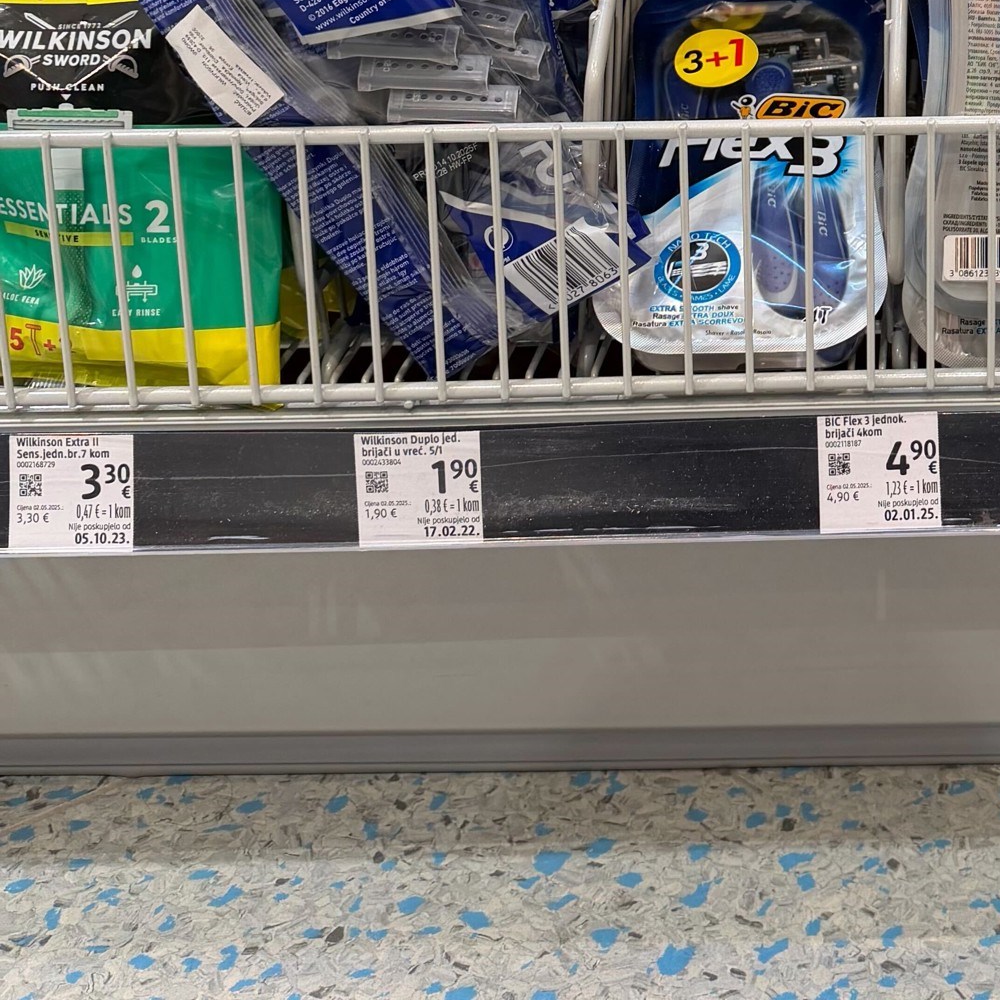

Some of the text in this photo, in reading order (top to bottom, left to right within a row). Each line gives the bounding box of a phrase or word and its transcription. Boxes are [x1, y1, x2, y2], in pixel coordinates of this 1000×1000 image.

[350, 5, 378, 25] Country
[378, 0, 387, 8] of
[0, 29, 152, 50] WILKINSON
[43, 54, 100, 66] SWORD
[683, 39, 745, 75] 3+1
[145, 200, 170, 232] 2
[825, 415, 906, 426] BIC Flex 3 jednok.
[361, 432, 460, 445] Wilkinson Duplo jed.
[825, 428, 882, 439] brijači 4kom
[825, 440, 862, 448] 0002118187
[827, 491, 859, 503] 4,90 €
[884, 508, 938, 521] 02.01.25.
[424, 525, 480, 537] 17.02.22.
[75, 532, 129, 544] 05.10.23.
